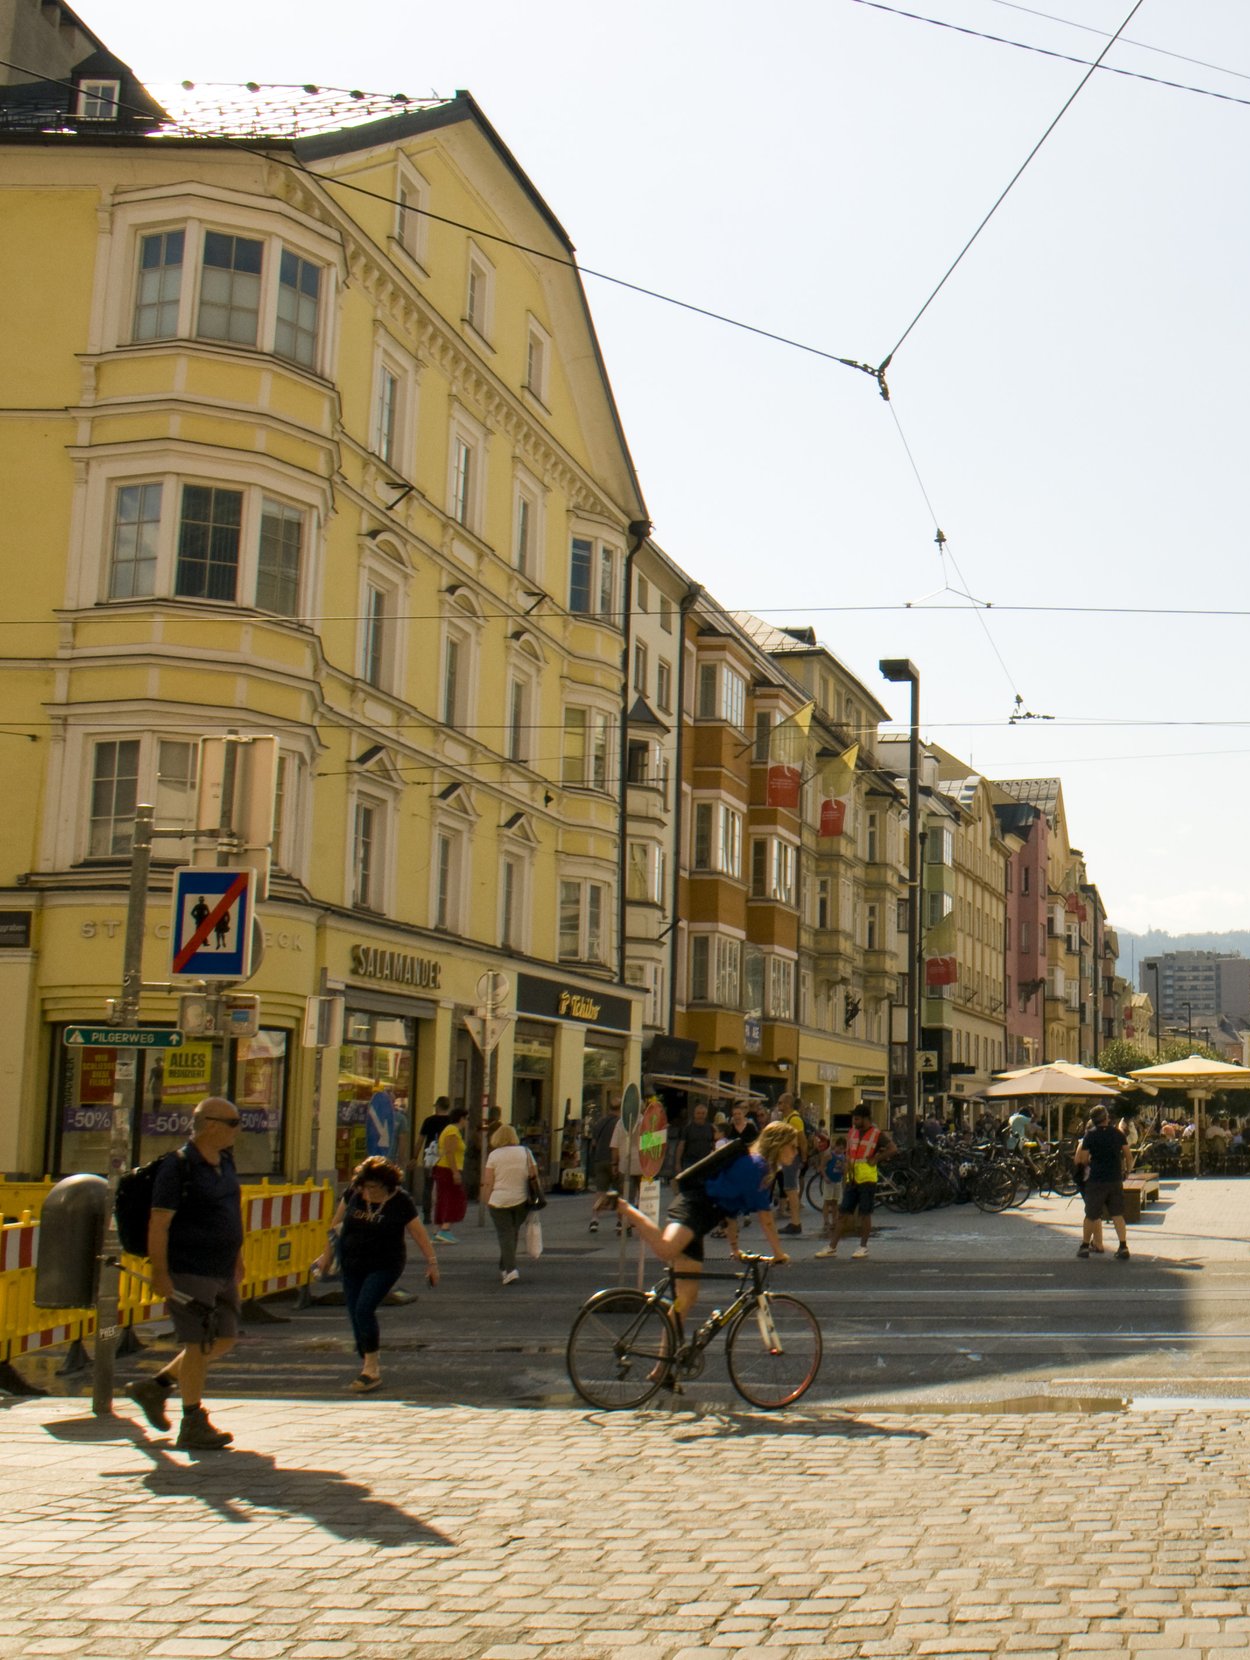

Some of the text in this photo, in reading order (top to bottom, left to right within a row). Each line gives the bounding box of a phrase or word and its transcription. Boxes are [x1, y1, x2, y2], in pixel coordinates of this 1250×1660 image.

[355, 945, 441, 989] SALAMANDER
[571, 995, 600, 1020] Tchibo
[91, 1032, 155, 1044] PILGERWEG
[170, 1053, 206, 1068] ALLES
[68, 1111, 111, 1128] -50%
[149, 1115, 195, 1132] -50%
